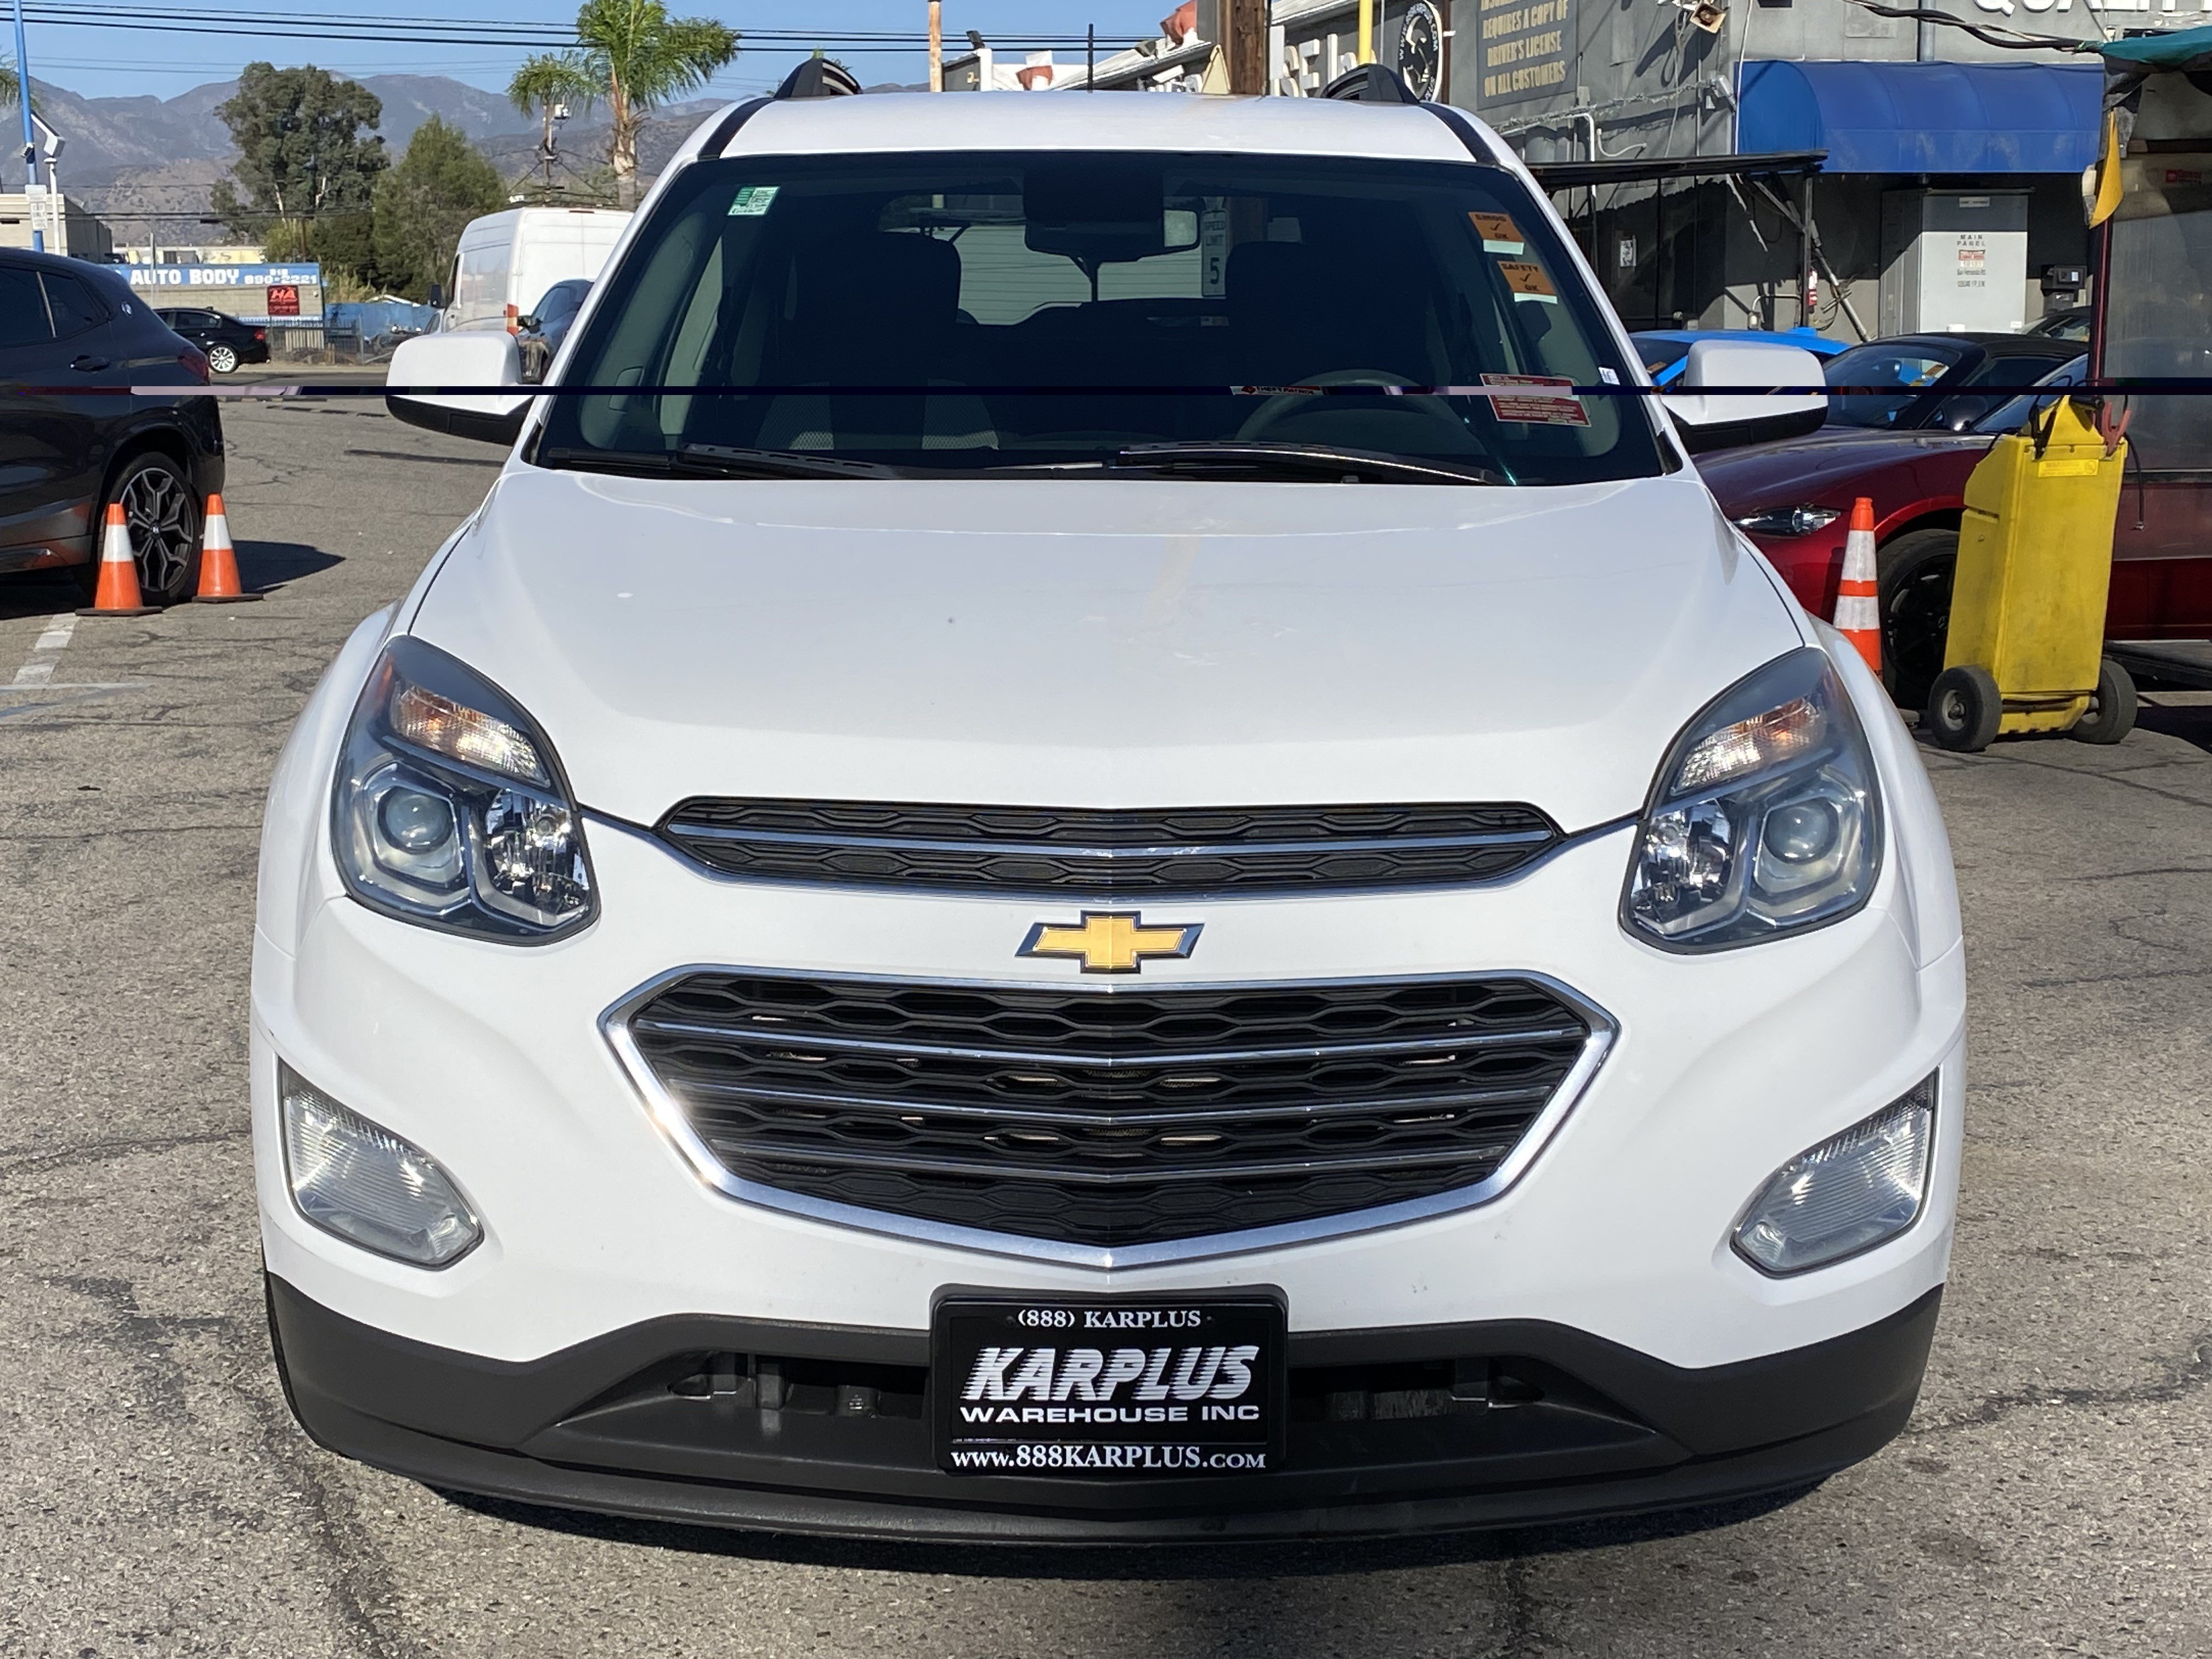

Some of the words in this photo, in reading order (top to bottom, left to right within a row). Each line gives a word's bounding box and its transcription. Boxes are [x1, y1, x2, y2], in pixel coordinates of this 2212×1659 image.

[1482, 9, 1522, 39] REQUIRES
[1523, 8, 1530, 28] A
[1531, 1, 1555, 27] COPY
[1556, 0, 1568, 21] OF
[1487, 39, 1525, 67] DRIVER'S
[1525, 30, 1562, 58] LICENSE
[1485, 75, 1497, 97] ON
[1498, 72, 1512, 94] ALL
[1512, 60, 1566, 91] CUSTOMERS
[130, 268, 182, 285] AUTO
[189, 268, 239, 285] BODY
[1500, 263, 1538, 272] SAFETY
[1018, 1309, 1075, 1328] (888)
[1084, 1309, 1201, 1328] KARPLUS
[959, 1345, 1260, 1401] KARPLUS
[960, 1406, 1188, 1424] WAREHOUSE
[1201, 1404, 1260, 1421] INC
